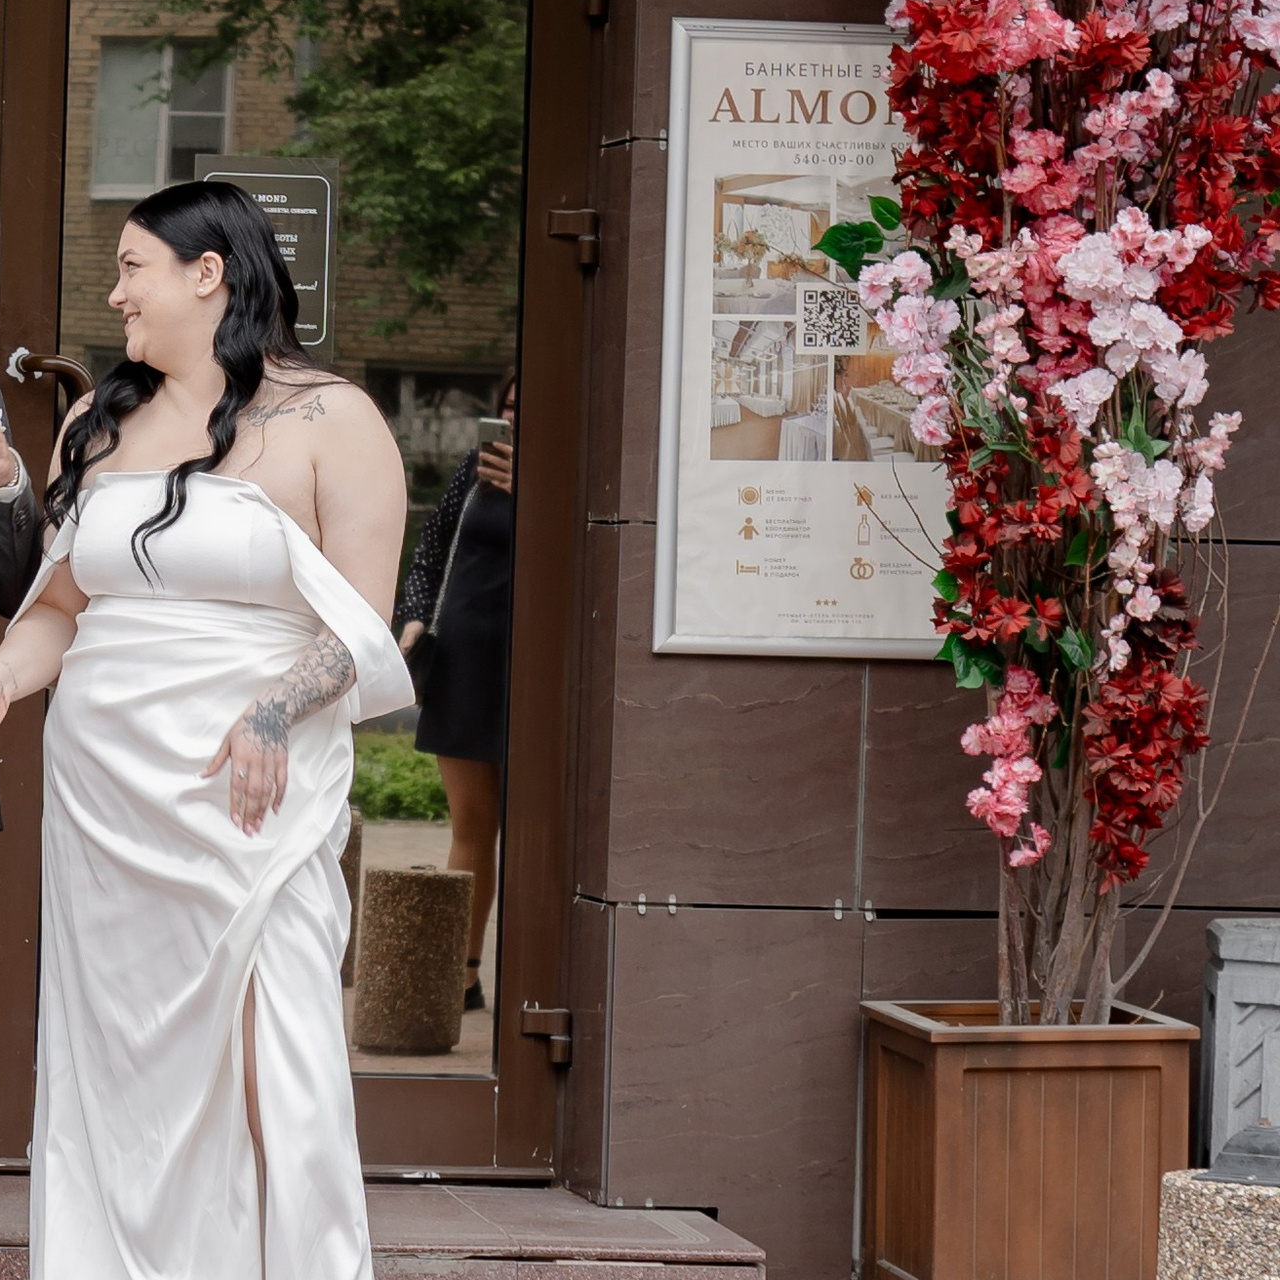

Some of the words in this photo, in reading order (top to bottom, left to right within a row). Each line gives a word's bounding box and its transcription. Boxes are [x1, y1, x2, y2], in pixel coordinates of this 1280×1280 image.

[745, 62, 863, 78] БАНКЕТНЫЕ
[732, 139, 769, 149] МЕСТО
[773, 140, 811, 149] ВАШИХ
[815, 141, 886, 150] СЧАСТЛИВЫХ
[793, 153, 875, 165] 540-09-00
[252, 194, 288, 203] LMOND
